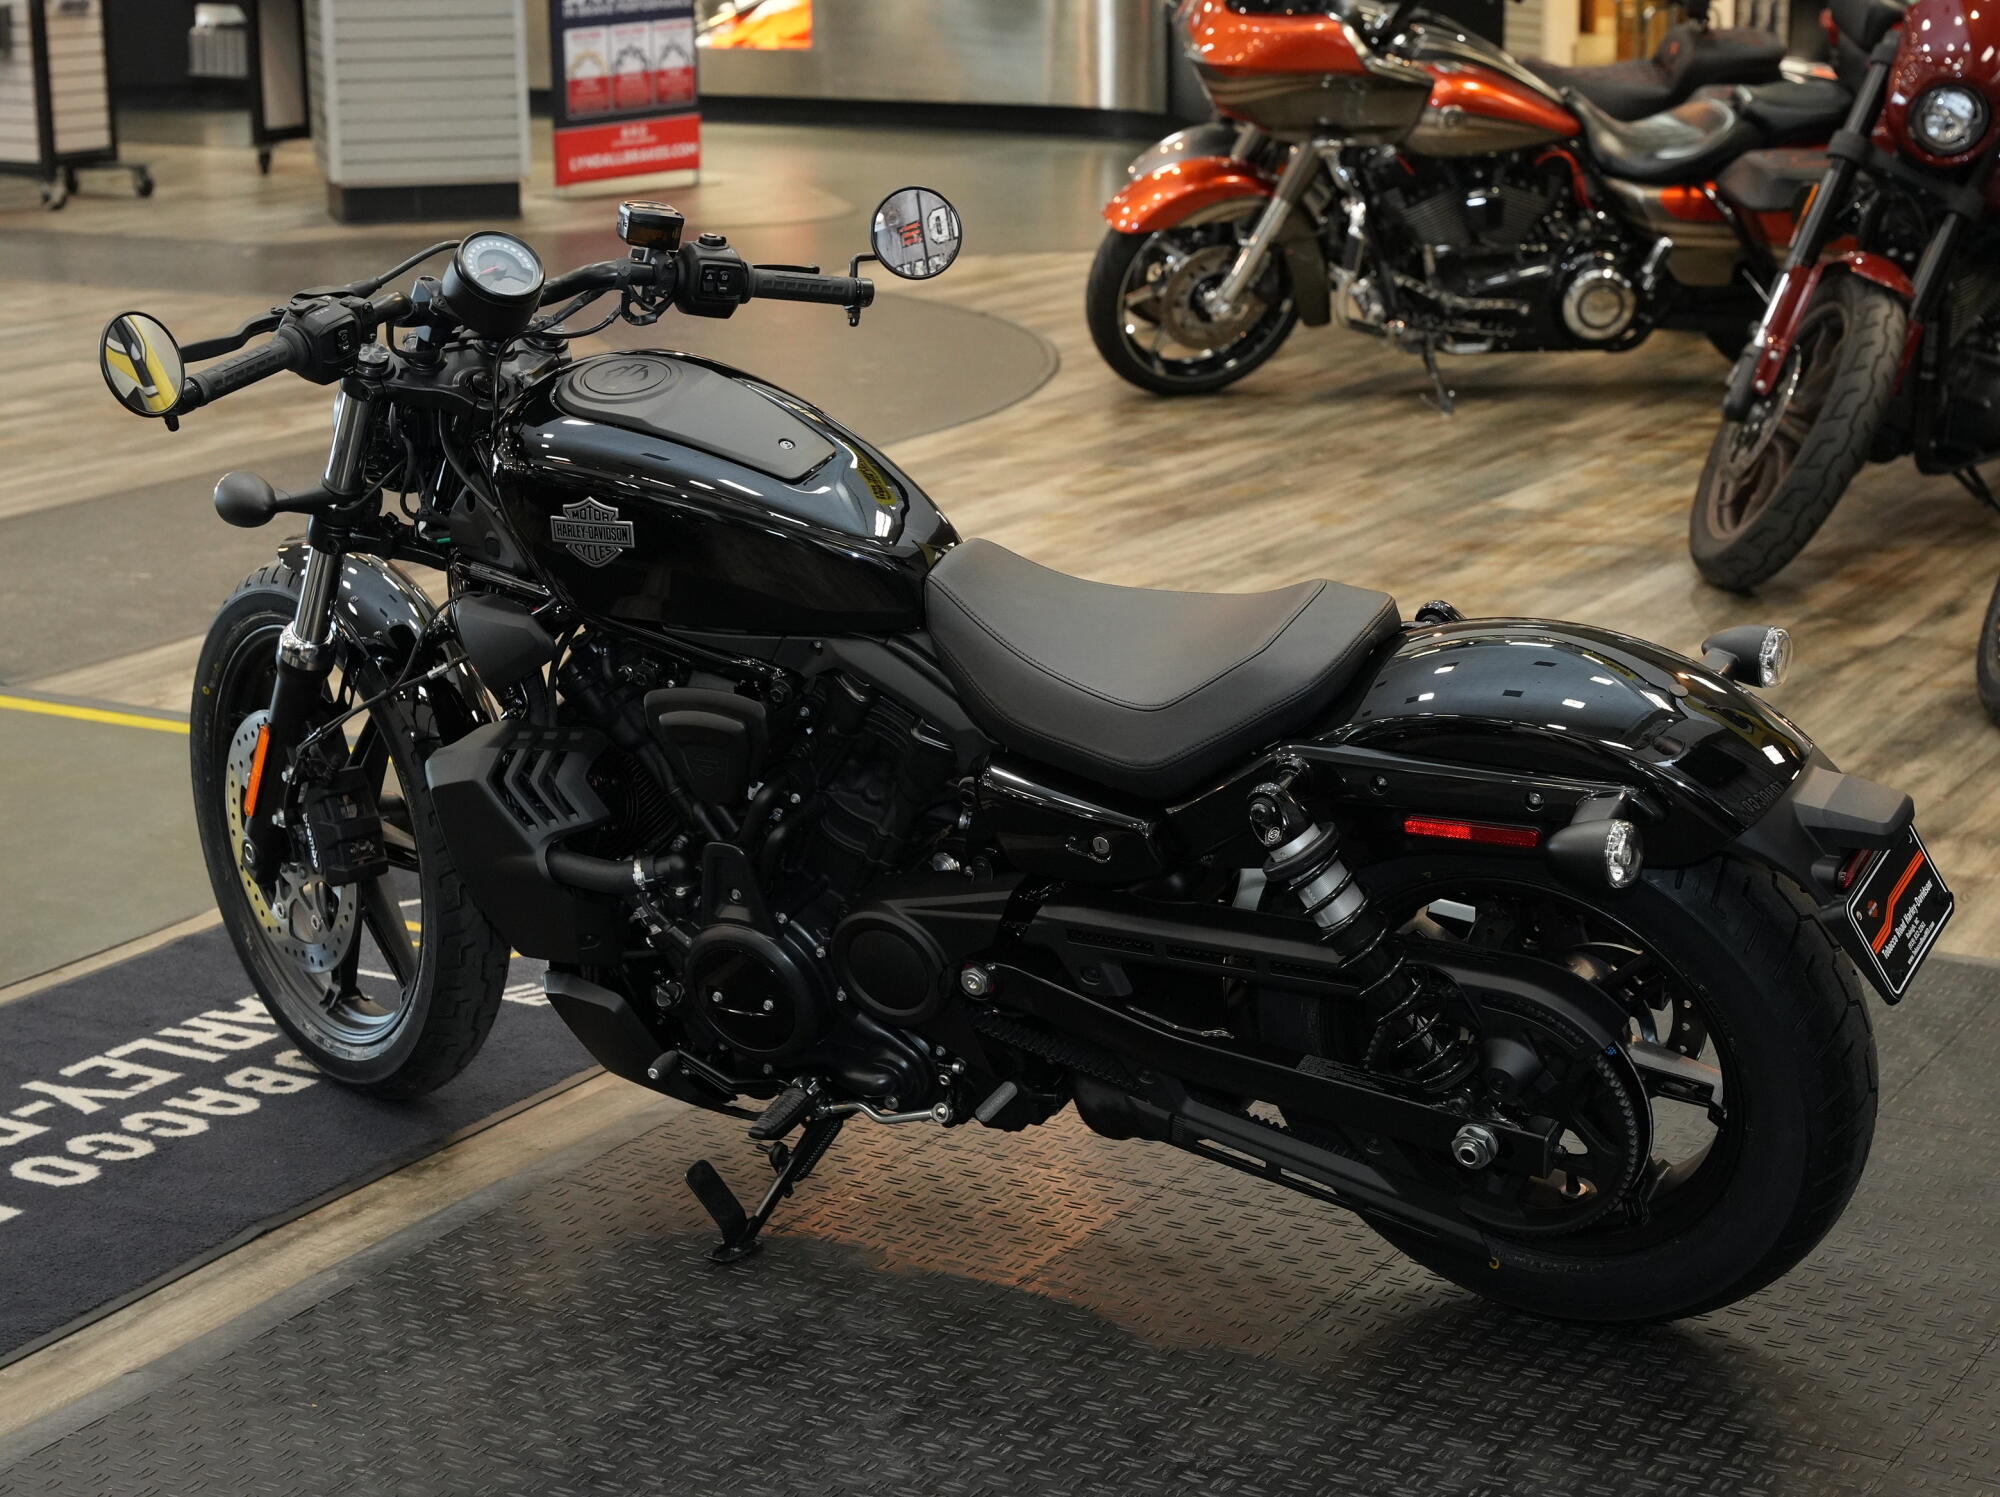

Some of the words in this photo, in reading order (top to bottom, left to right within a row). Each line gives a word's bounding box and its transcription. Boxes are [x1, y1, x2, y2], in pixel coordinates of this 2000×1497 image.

[571, 505, 610, 522] MOTOR
[556, 523, 629, 542] HARLEY-DAVIDSON
[574, 543, 612, 561] CYCLES
[302, 811, 319, 868] brembo
[1882, 934, 1899, 959] Tobacco
[1894, 918, 1908, 938] Road
[1903, 879, 1933, 925] Harley-Davidson
